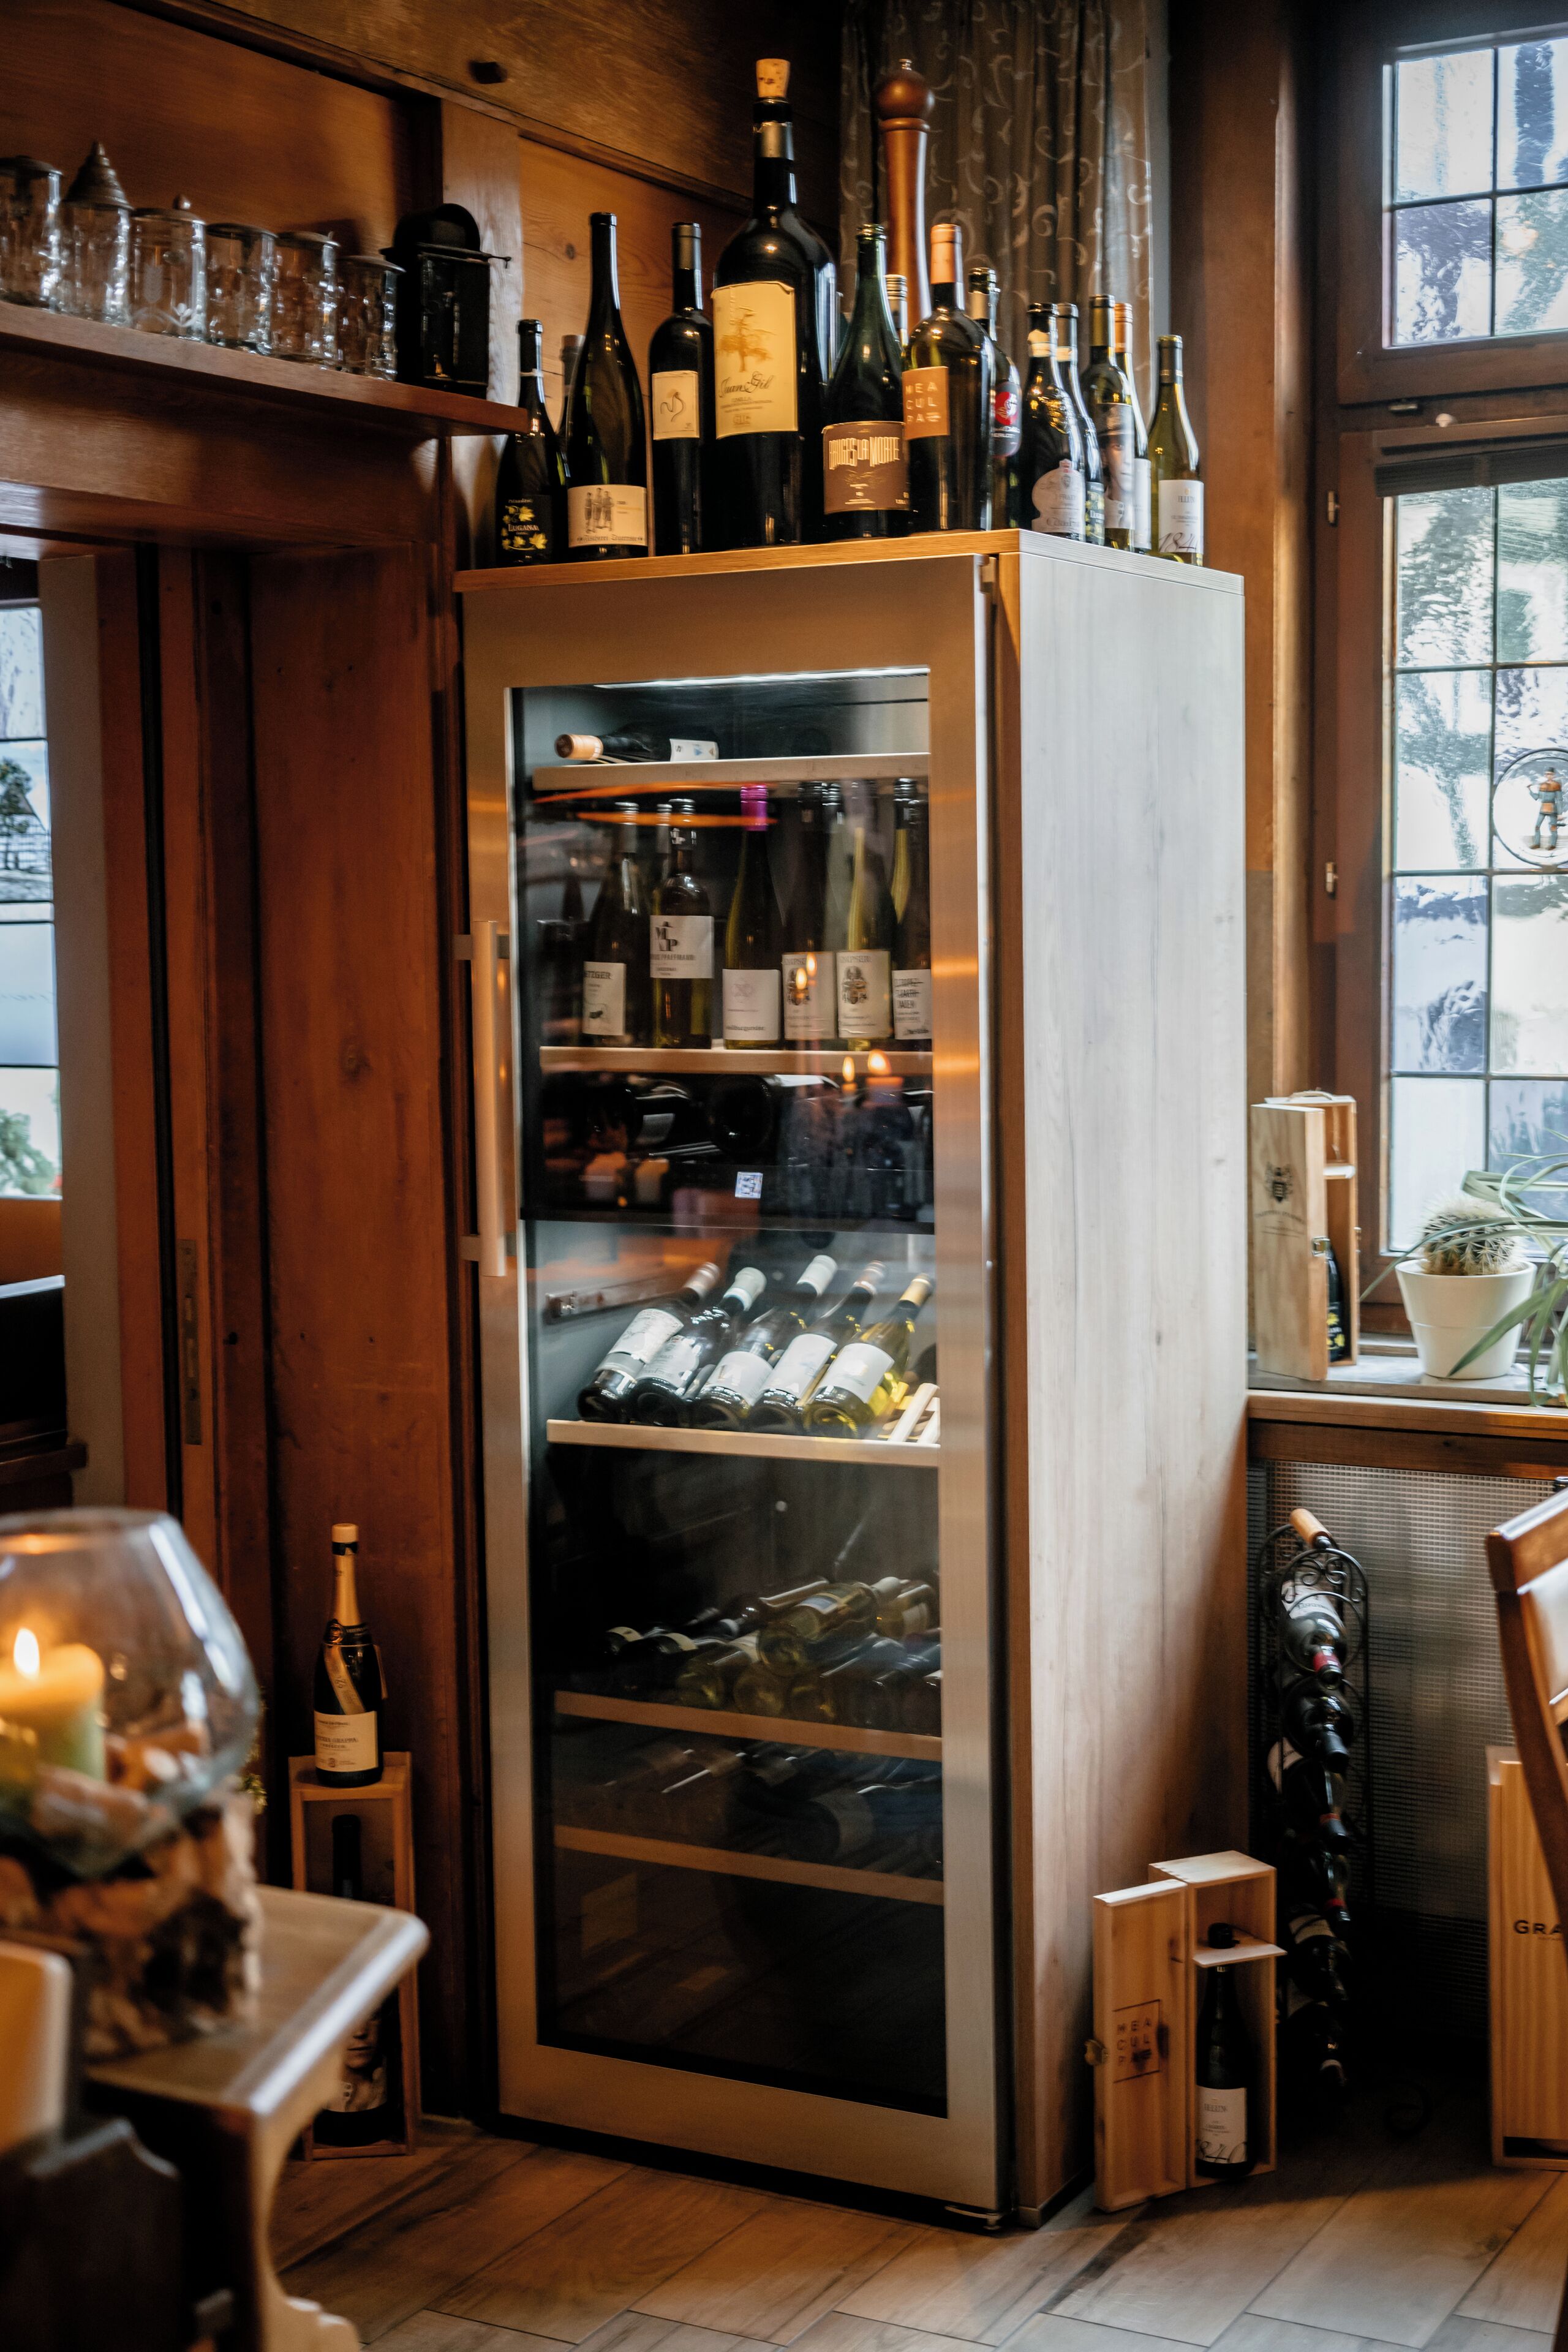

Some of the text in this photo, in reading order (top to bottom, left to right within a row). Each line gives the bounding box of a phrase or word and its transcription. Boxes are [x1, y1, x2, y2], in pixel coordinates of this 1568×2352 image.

[905, 375, 938, 395] MEA
[906, 397, 938, 410] CUL
[1513, 1919, 1562, 1935] GRA
